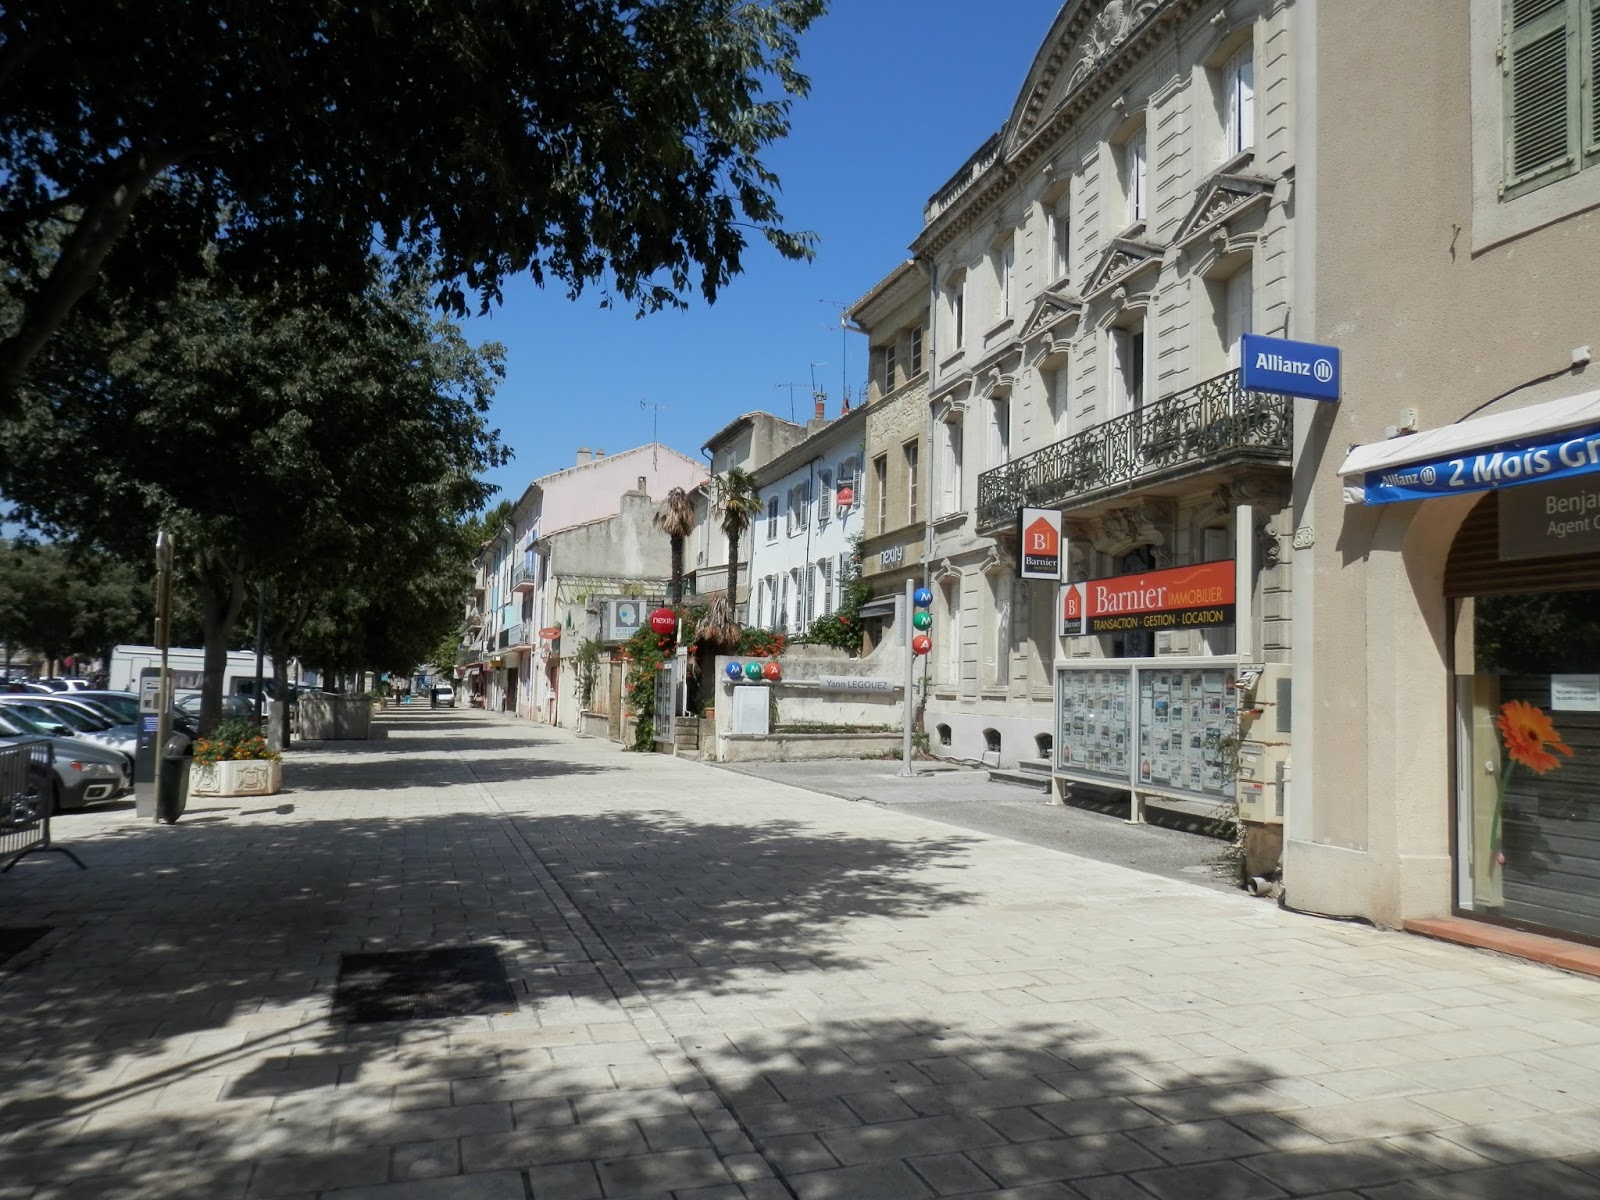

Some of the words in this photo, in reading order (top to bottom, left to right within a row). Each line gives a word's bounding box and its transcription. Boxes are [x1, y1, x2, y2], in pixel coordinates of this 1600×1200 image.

[1256, 353, 1310, 376] Allianz
[1380, 473, 1419, 488] Allianz
[1448, 460, 1464, 487] 2
[1473, 448, 1550, 483] Mois
[1546, 490, 1600, 515] Benja
[1547, 518, 1590, 538] Agent
[880, 545, 902, 564] nexity
[1026, 556, 1057, 567] Barnier
[1096, 580, 1166, 613] Barnier
[1168, 586, 1222, 606] IMMOBILIER
[652, 617, 675, 625] nexity
[1094, 617, 1138, 630] TRANSACTION
[1144, 614, 1175, 627] GESTION
[1182, 610, 1223, 624] LOCATION
[826, 680, 845, 688] Yann
[847, 680, 888, 690] LEGOUEZ
